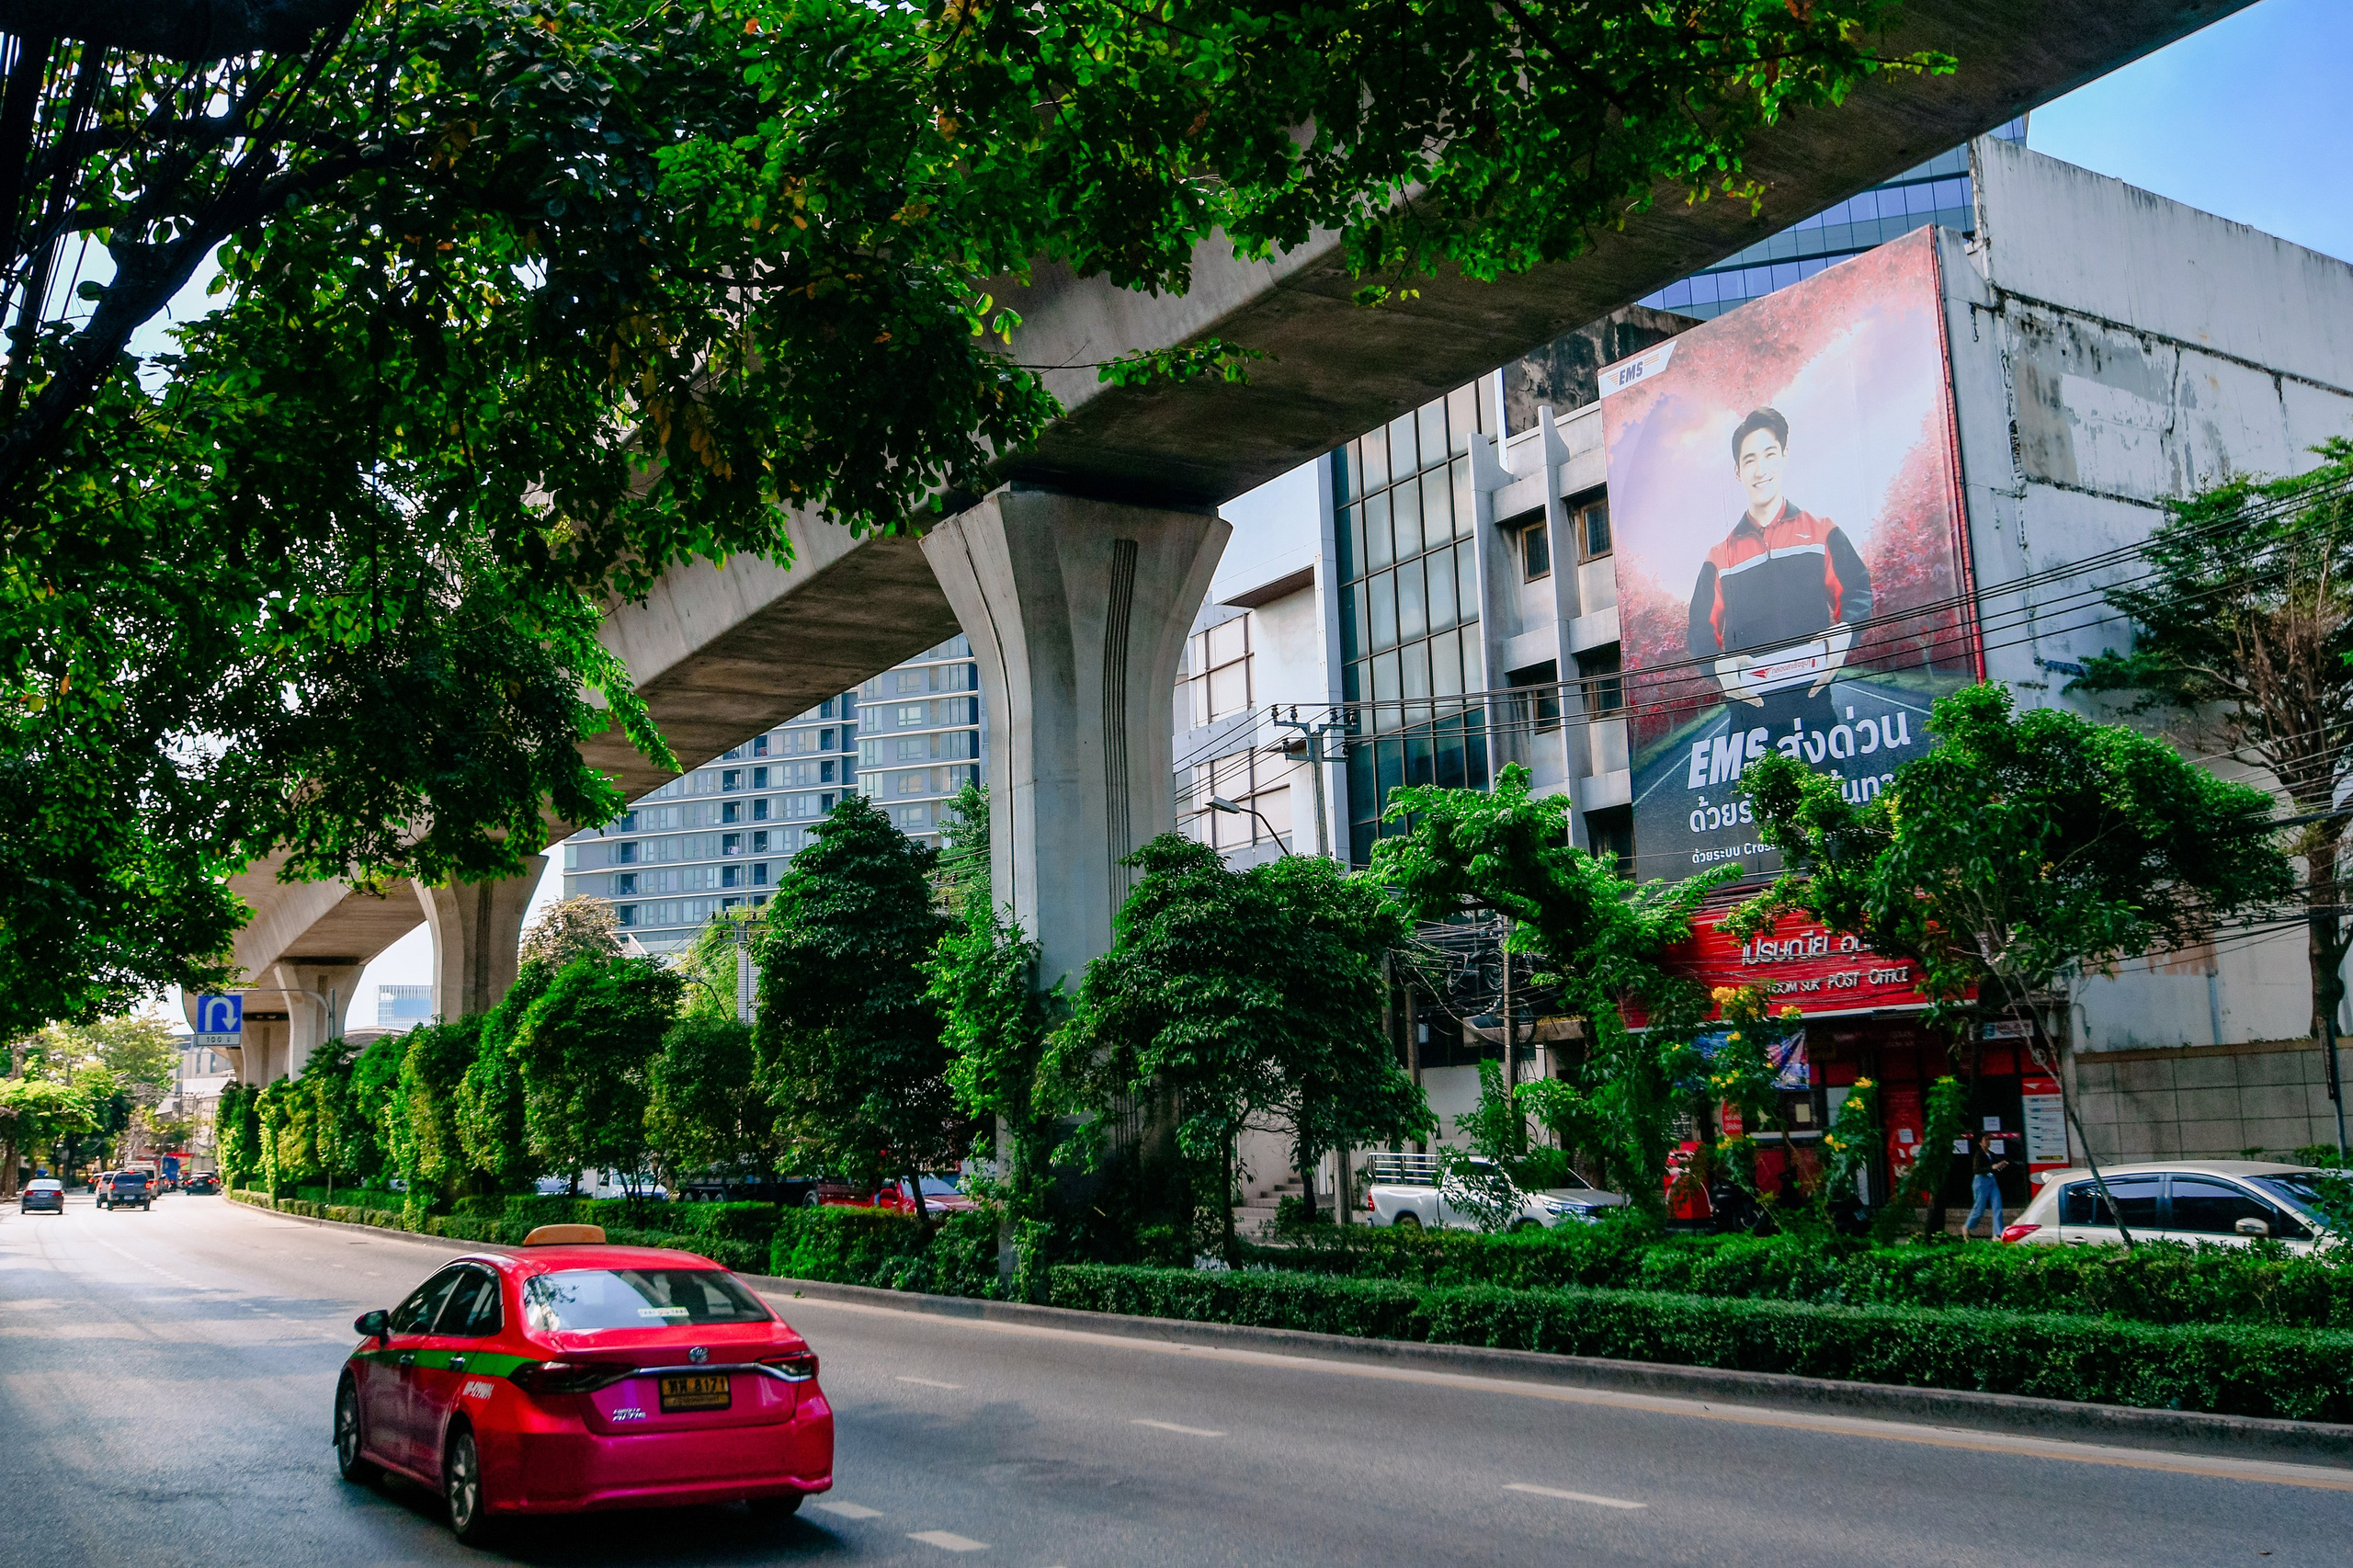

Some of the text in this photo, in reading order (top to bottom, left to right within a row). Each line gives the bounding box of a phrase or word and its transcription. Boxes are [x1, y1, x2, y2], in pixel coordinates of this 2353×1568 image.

[1619, 361, 1643, 386] EMS
[1688, 706, 1912, 790] EMS ส่งด่วน
[1692, 846, 1740, 864] ด้วยระบบ
[1827, 971, 1860, 989] POST
[1868, 966, 1909, 985] OFFICE
